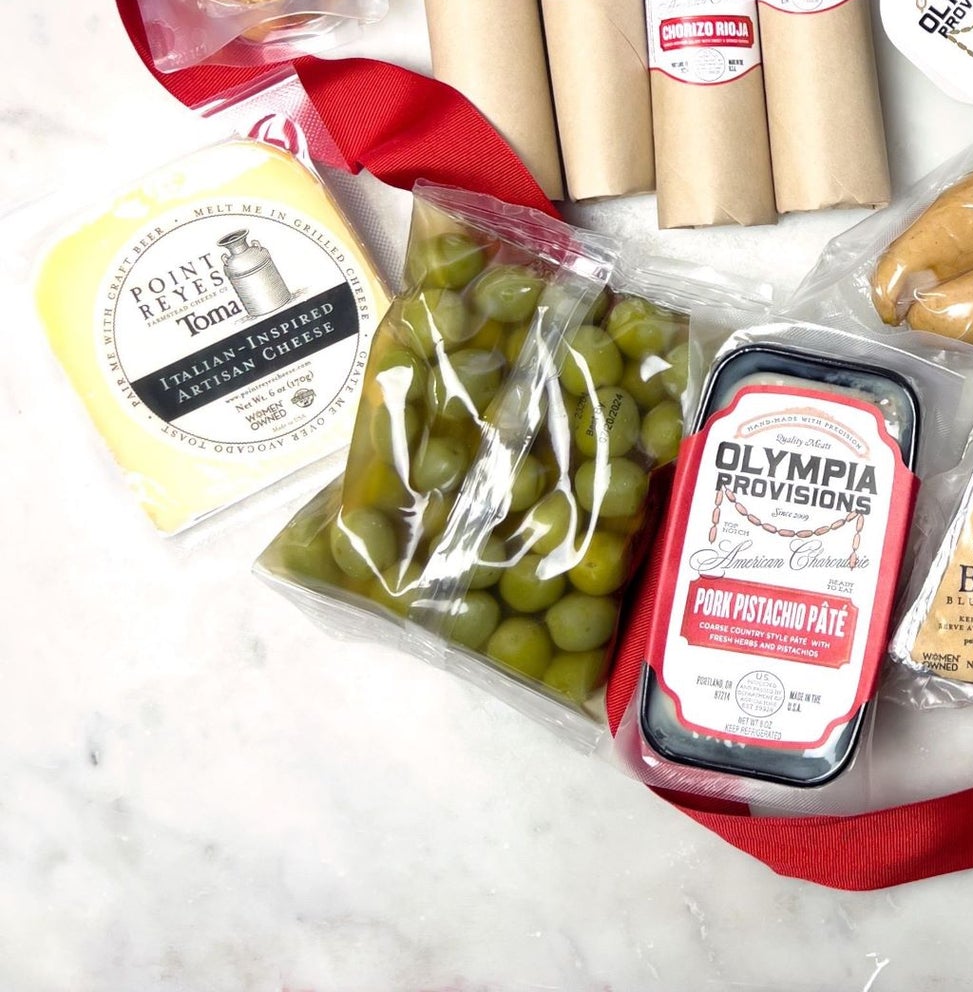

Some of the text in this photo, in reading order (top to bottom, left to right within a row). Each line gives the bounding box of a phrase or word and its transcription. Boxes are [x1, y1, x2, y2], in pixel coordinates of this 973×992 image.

[662, 21, 749, 41] CHORIZO RIOJA
[129, 253, 214, 303] POINT
[193, 204, 370, 321] MELT ME IN GRILLED CHEESE
[103, 226, 164, 408] PAIR ME WITH CRAFT BEER
[138, 270, 224, 321] REYES
[175, 299, 243, 338] Toma
[159, 302, 335, 392] ITALIAN-INSPIRED
[176, 321, 336, 404] ARTISAN CHEESE
[235, 401, 252, 413] Net
[250, 409, 288, 431] OWNED
[161, 417, 326, 455] OVER AVOCADO TOAST
[715, 441, 878, 495] OLYMPIA
[715, 471, 872, 516] PROVISIONS
[693, 587, 849, 638] PORK PISTACHIO PÂTÉ
[699, 622, 831, 649] COARSE COUNTRY STYLE WITH
[709, 634, 776, 651] FRESH HERBS AND
